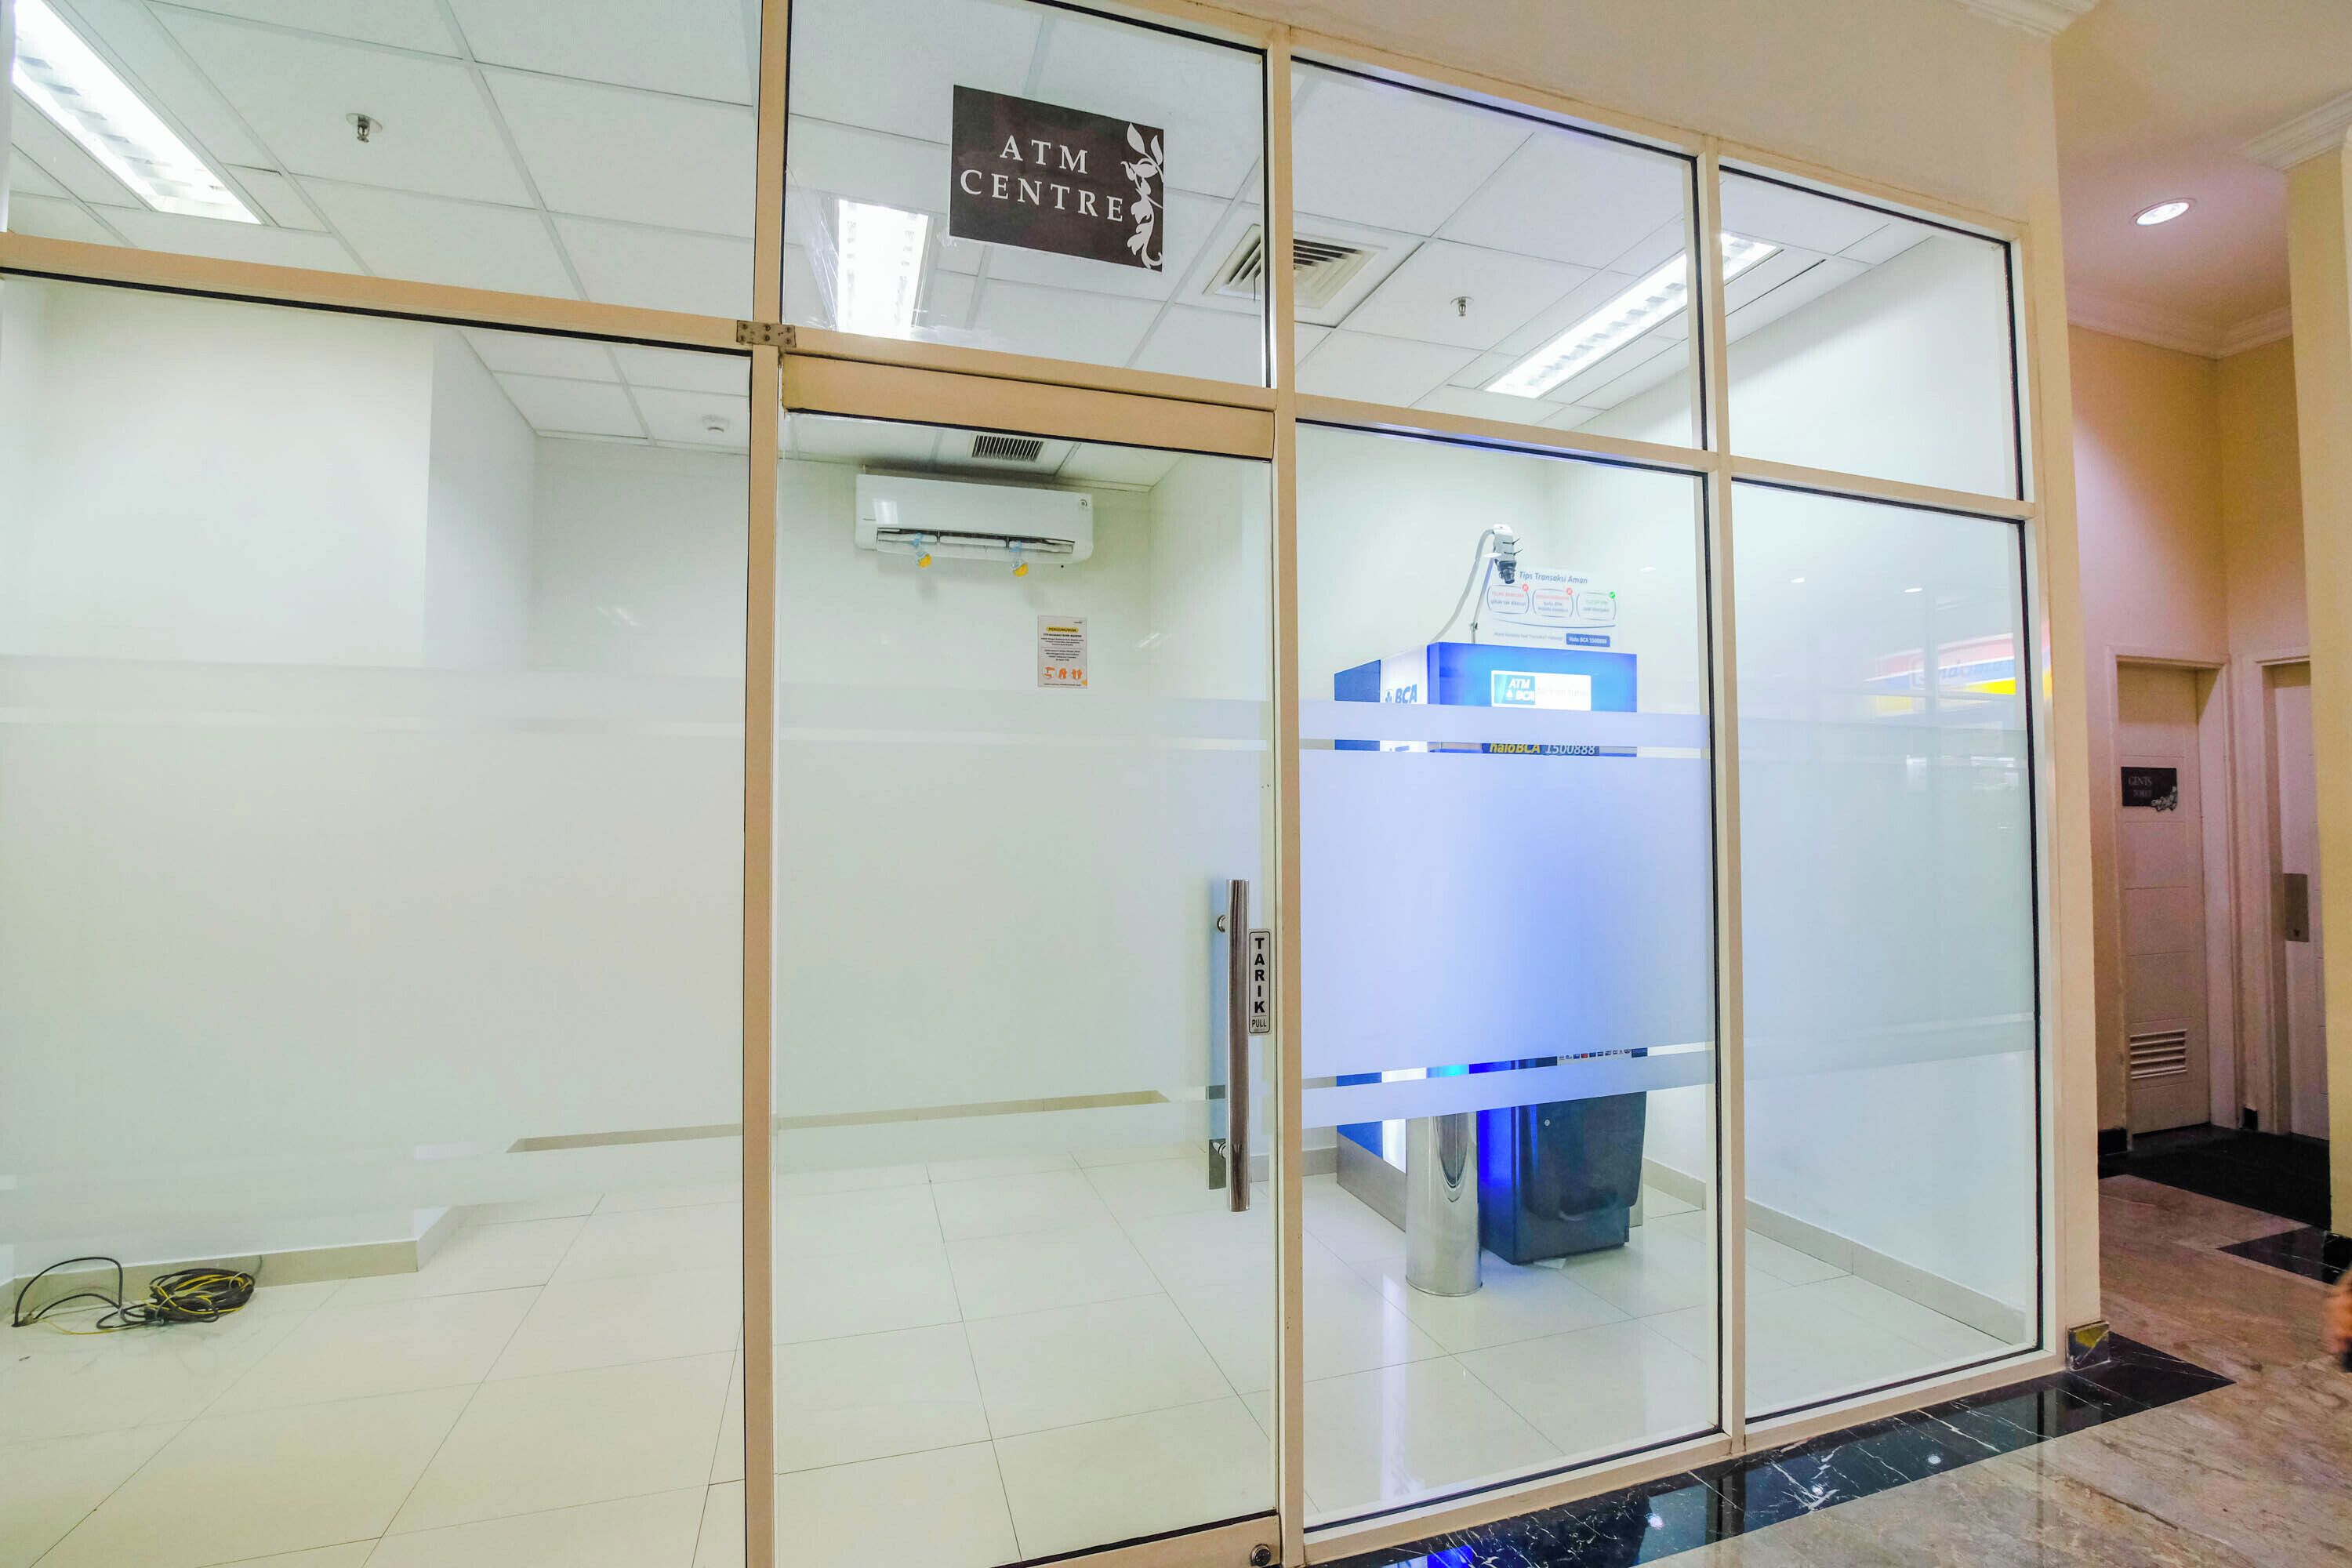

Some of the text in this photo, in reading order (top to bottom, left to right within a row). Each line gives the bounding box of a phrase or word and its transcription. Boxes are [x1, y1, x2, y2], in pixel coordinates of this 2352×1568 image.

[1000, 134, 1088, 174] ATM
[960, 169, 1123, 222] CENTRE
[1519, 571, 1588, 584] Tips Transaksi Aman
[1508, 677, 1530, 689] ATM
[1395, 683, 1417, 704] BCA
[1545, 744, 1595, 755] 1500888
[1254, 937, 1265, 1014] TARIK
[1251, 1018, 1267, 1028] PULL
